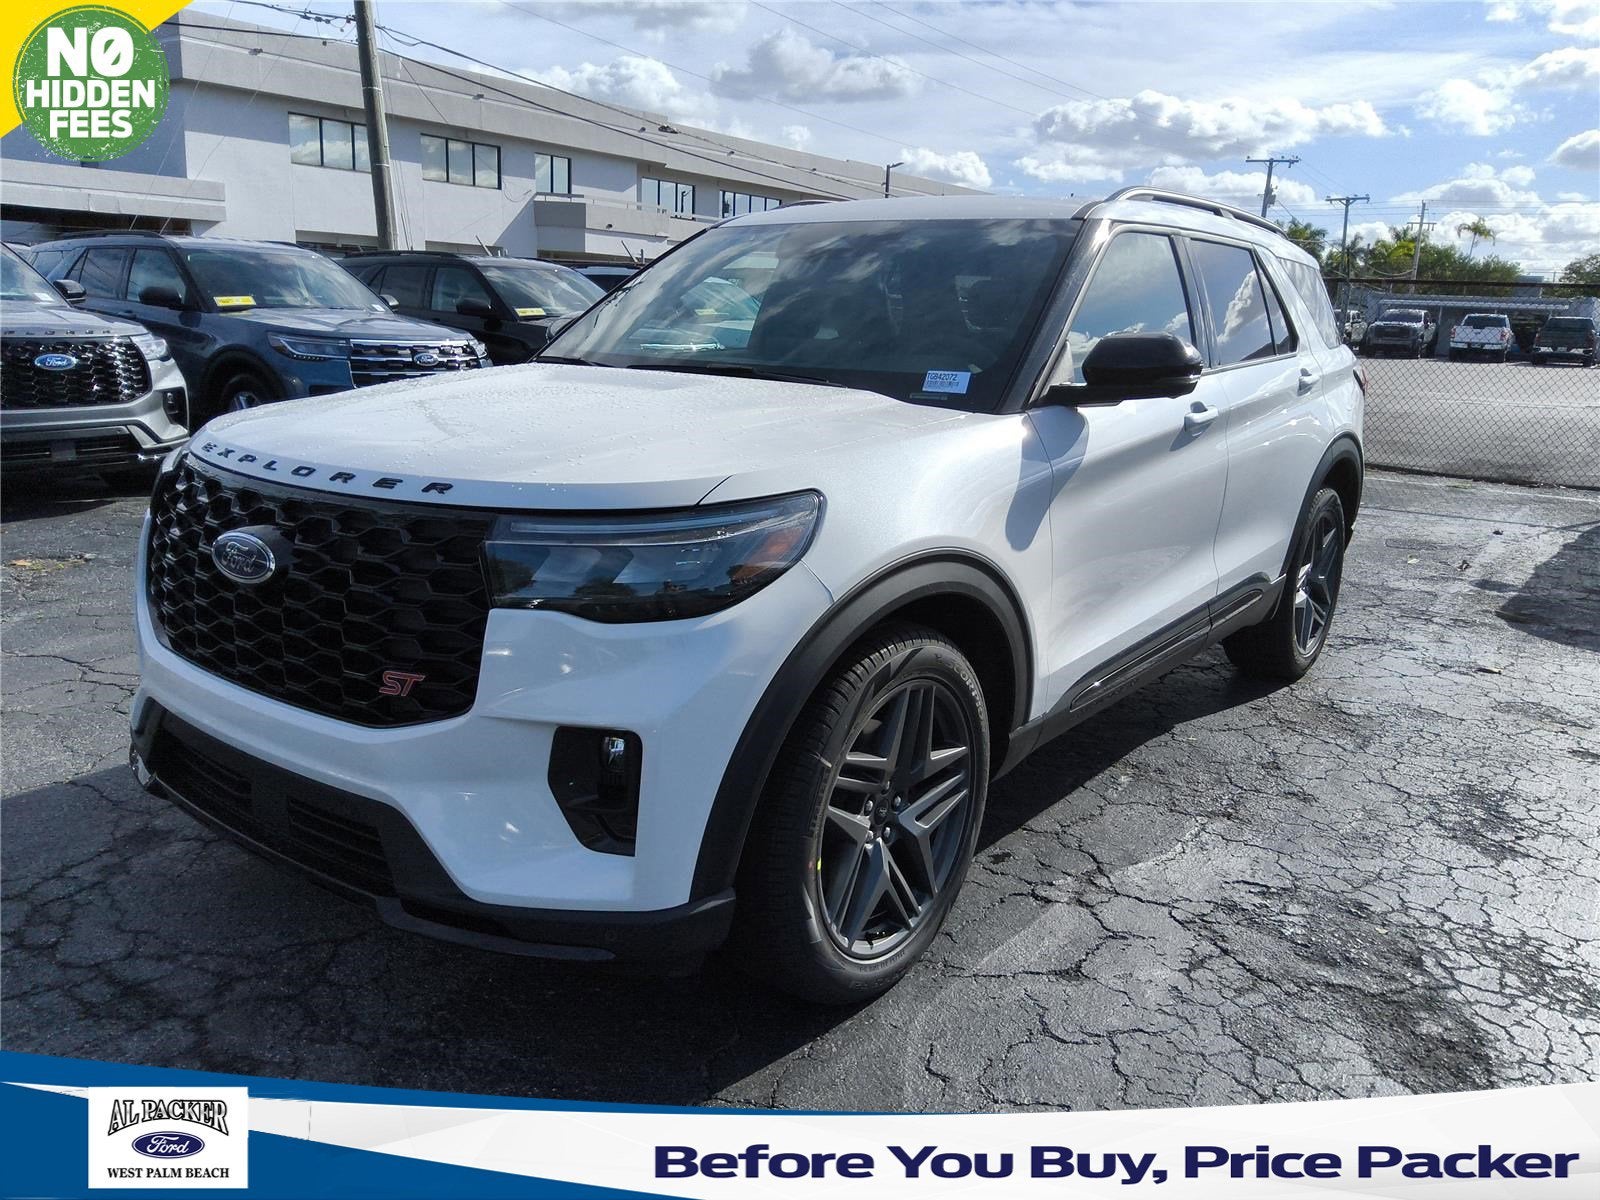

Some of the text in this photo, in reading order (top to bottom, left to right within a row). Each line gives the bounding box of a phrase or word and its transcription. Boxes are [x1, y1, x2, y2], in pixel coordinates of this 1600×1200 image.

[201, 442, 454, 494] EXPLORER
[222, 541, 257, 573] Ford
[378, 670, 426, 697] ST
